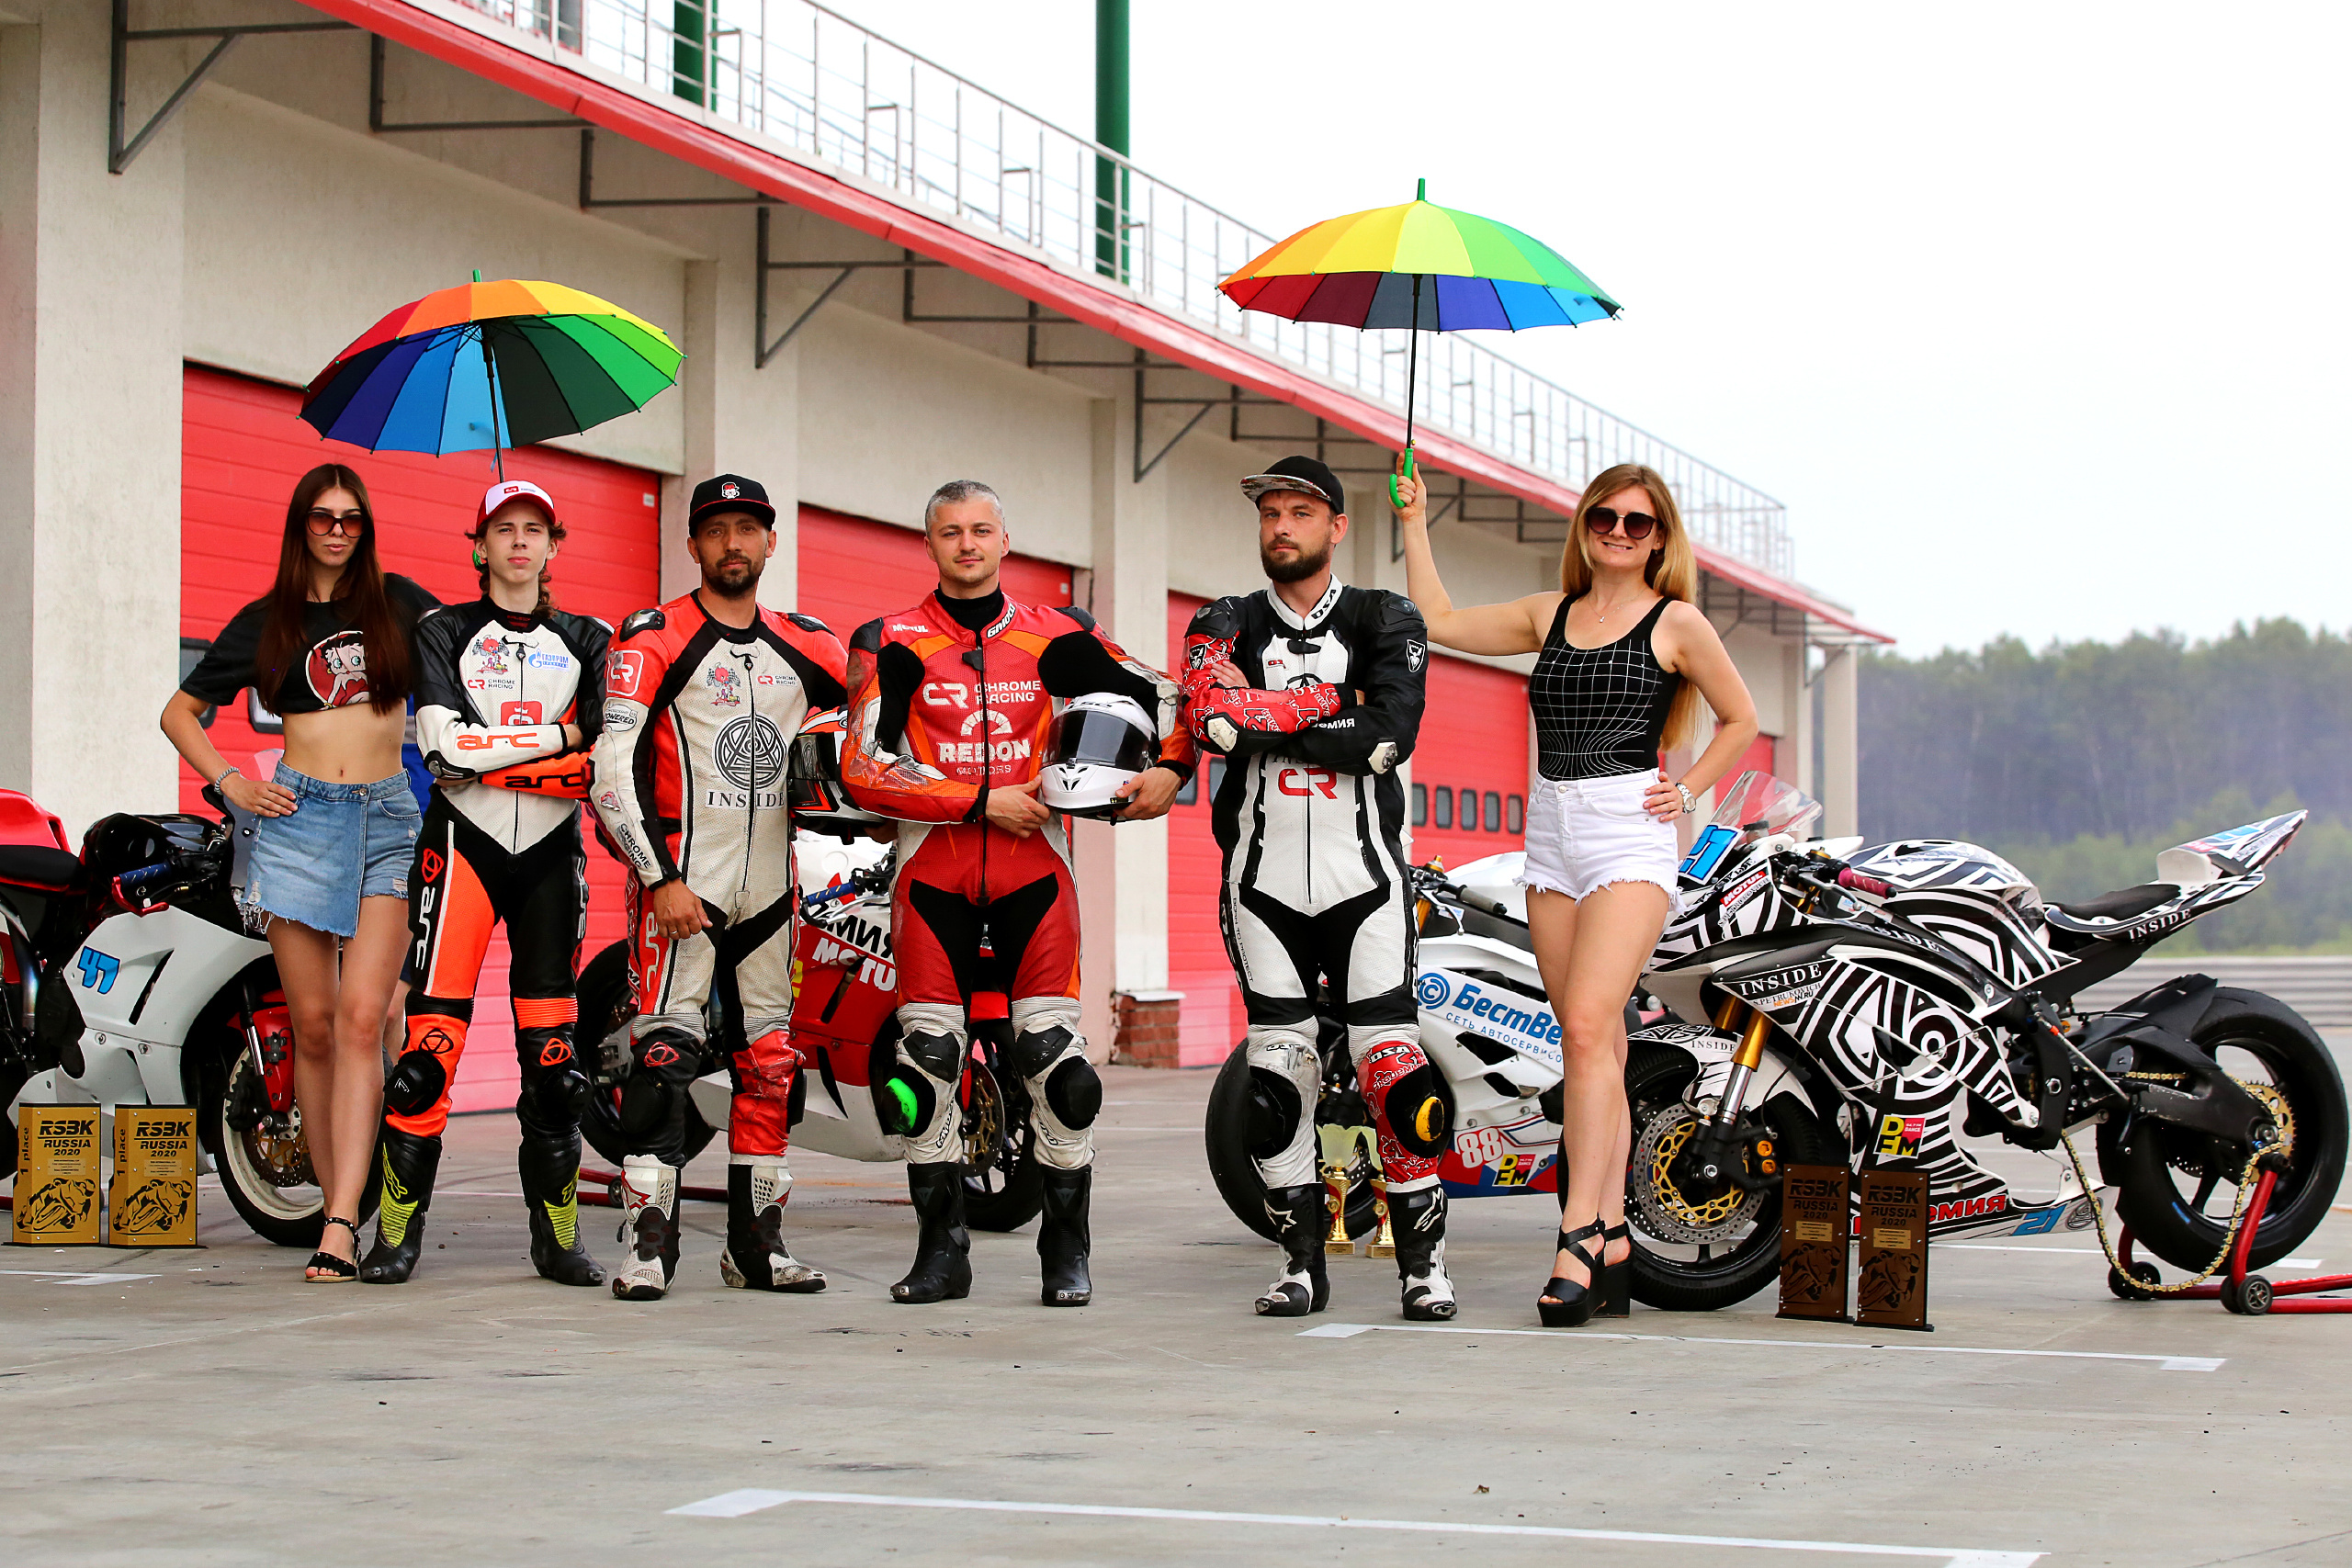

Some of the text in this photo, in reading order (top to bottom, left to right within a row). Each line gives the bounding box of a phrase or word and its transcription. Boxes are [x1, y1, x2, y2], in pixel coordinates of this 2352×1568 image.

[468, 679, 485, 689] CR
[757, 675, 774, 685] CR
[974, 680, 1041, 694] CHROME
[922, 682, 968, 708] CR
[976, 693, 1035, 705] RACING
[605, 713, 634, 725] OWERED
[457, 732, 540, 750] arc
[937, 739, 1031, 764] REDON
[1278, 767, 1338, 799] CR
[620, 823, 650, 869] CHROME
[1723, 872, 1764, 906] MOTUL
[2128, 908, 2192, 940] INSIDE
[77, 945, 120, 995] 47
[812, 937, 897, 992] MOTU
[1739, 963, 1823, 996] INSIDE
[1452, 983, 1562, 1047] БестВе
[1446, 1012, 1562, 1063] СЕТЬ АВТОСЕРВИСО
[40, 1120, 96, 1135] RSBK
[136, 1121, 192, 1136] RSBK
[22, 1127, 30, 1161] place
[43, 1139, 91, 1148] RUSSIA
[119, 1128, 127, 1163] place
[140, 1141, 187, 1150] RUSSIA
[1458, 1127, 1503, 1169] 88
[1791, 1179, 1843, 1198] RSBK
[1868, 1185, 1922, 1204] RSBK
[1793, 1200, 1838, 1211] RUSSIA
[1871, 1207, 1917, 1218] RUSSIA
[1881, 1218, 1906, 1226] 2020
[2011, 1203, 2067, 1236] 21
